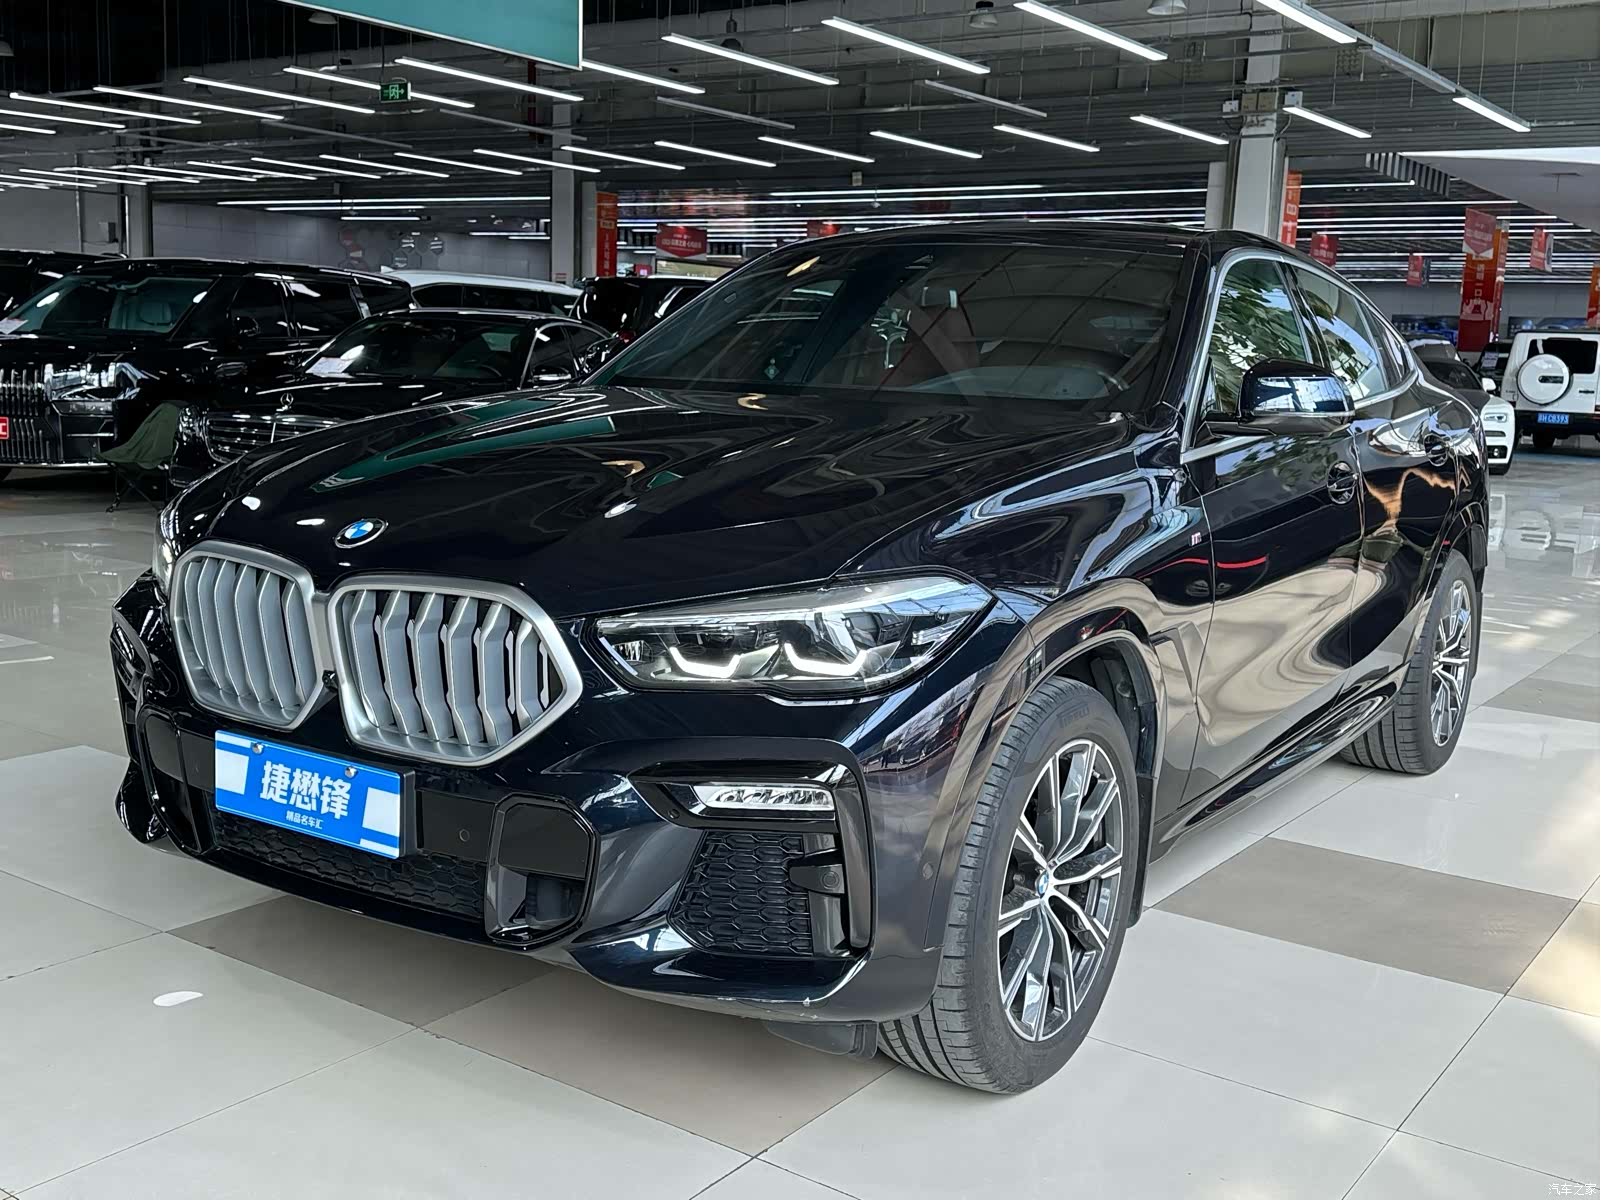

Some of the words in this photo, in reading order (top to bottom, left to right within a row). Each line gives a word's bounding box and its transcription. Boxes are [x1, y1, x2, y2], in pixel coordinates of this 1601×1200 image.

[260, 761, 352, 820] 捷懋锋
[286, 810, 324, 830] 精品名车汇
